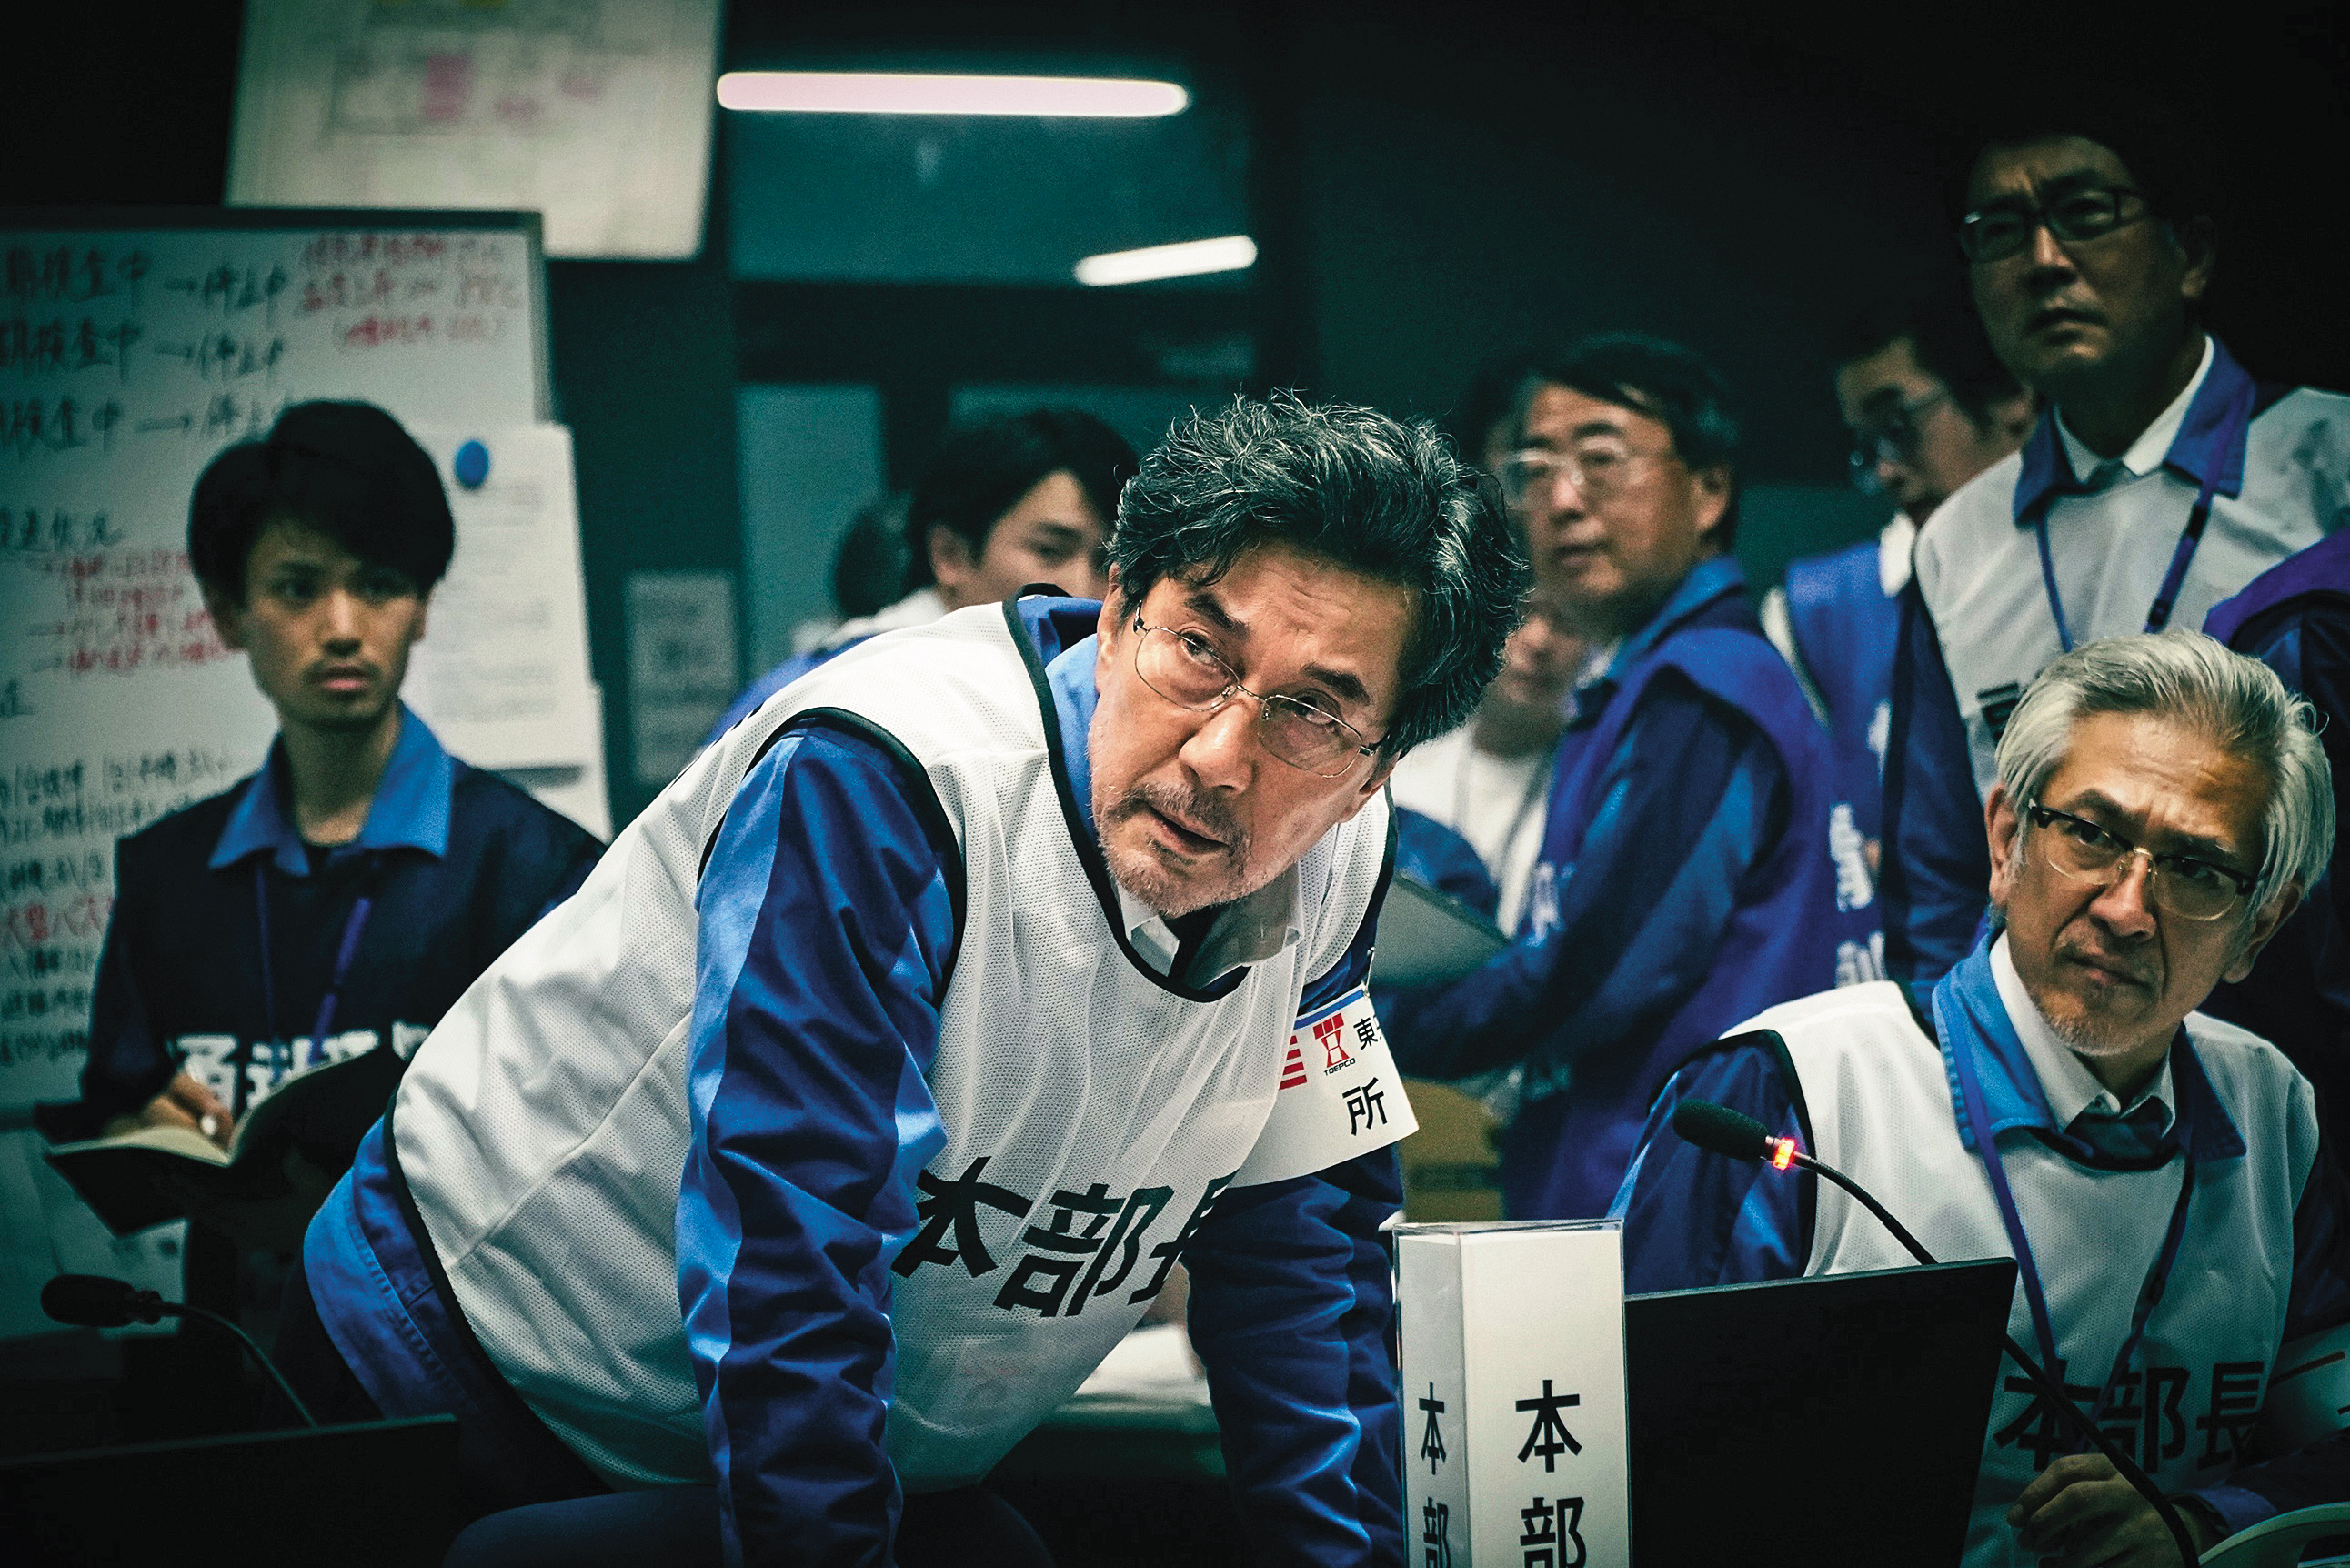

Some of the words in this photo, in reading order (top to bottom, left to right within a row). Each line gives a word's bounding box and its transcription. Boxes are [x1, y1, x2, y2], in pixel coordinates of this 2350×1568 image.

[1324, 1057, 1356, 1076] TOEPCO
[1342, 1077, 1388, 1136] 所
[1515, 1379, 1587, 1568] 本部
[1993, 1359, 2265, 1474] 本部長
[1418, 1382, 1451, 1568] 本部
